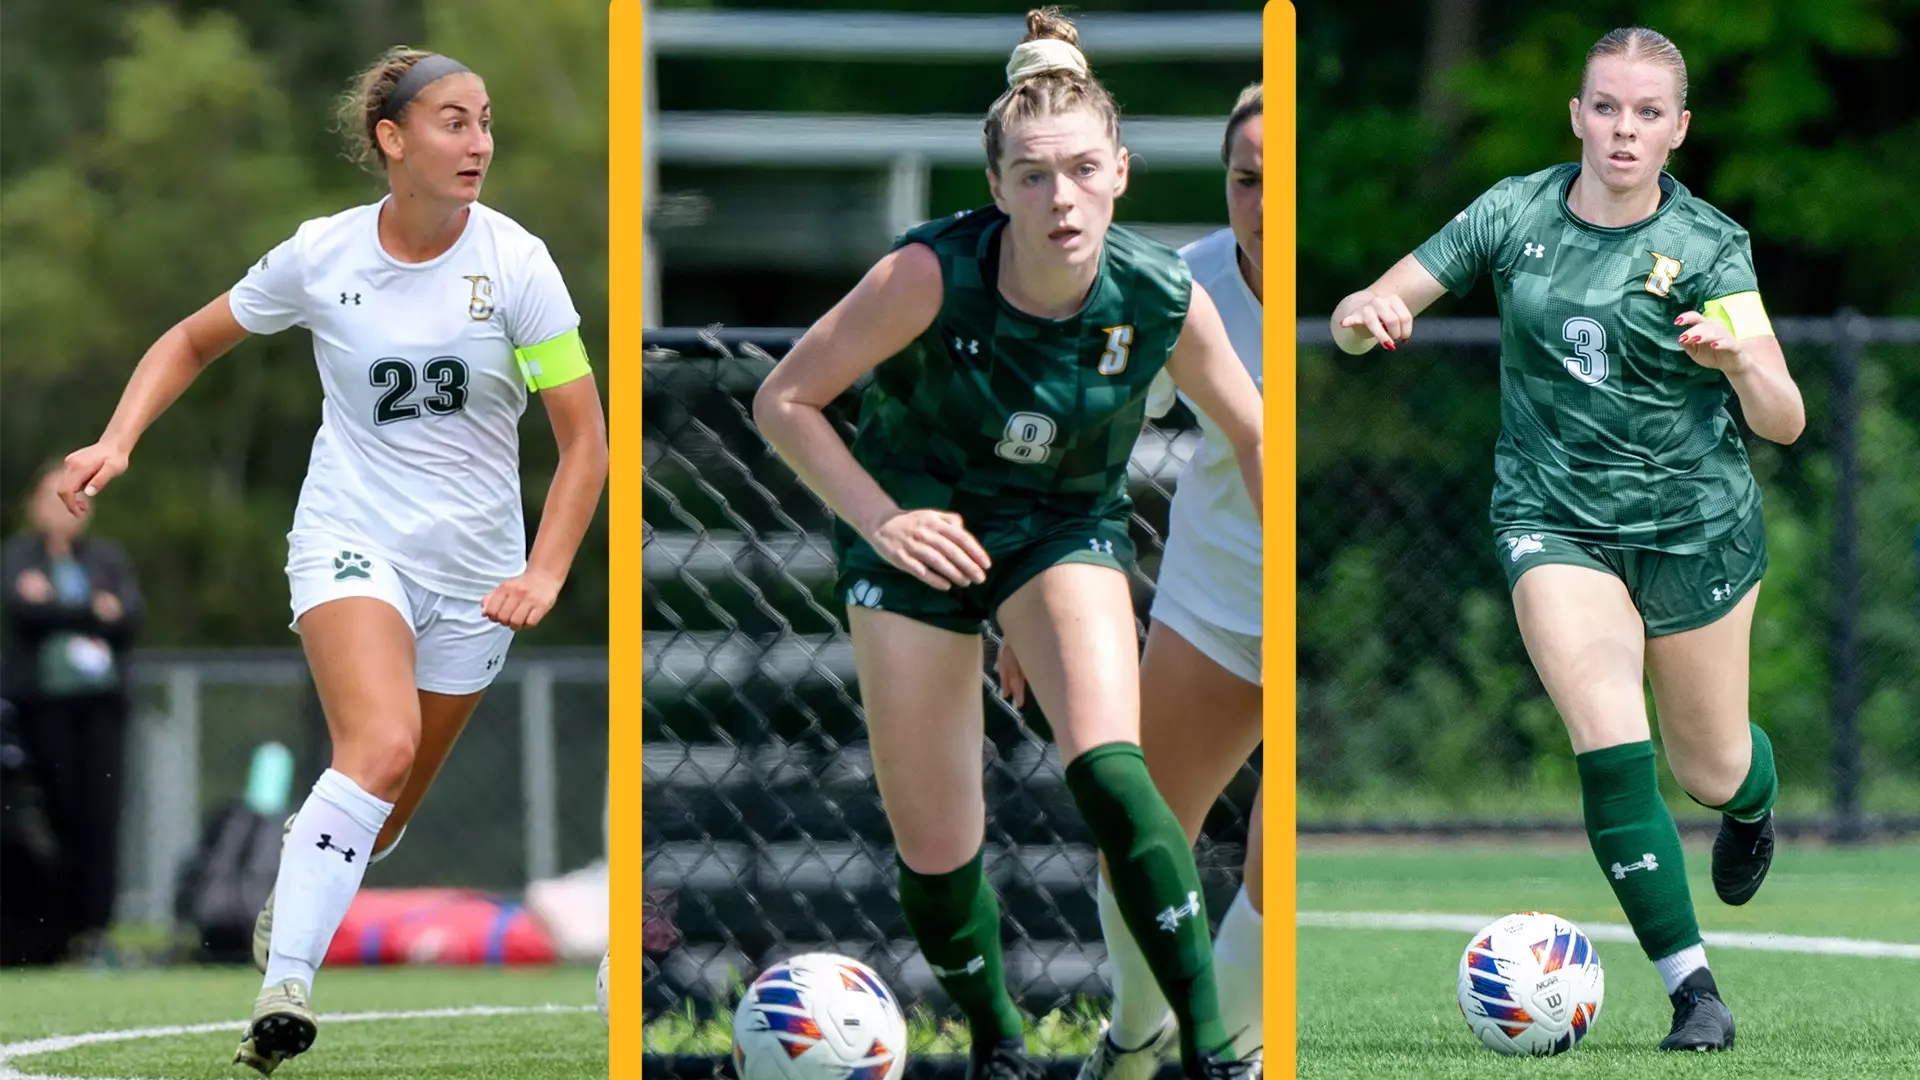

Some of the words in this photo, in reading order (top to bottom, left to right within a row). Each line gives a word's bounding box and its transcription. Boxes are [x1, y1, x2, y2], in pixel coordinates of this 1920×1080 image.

[1098, 324, 1134, 375] S
[1562, 316, 1609, 386] 3
[369, 355, 469, 426] 23
[995, 411, 1057, 464] 8
[1535, 976, 1559, 991] NCAA
